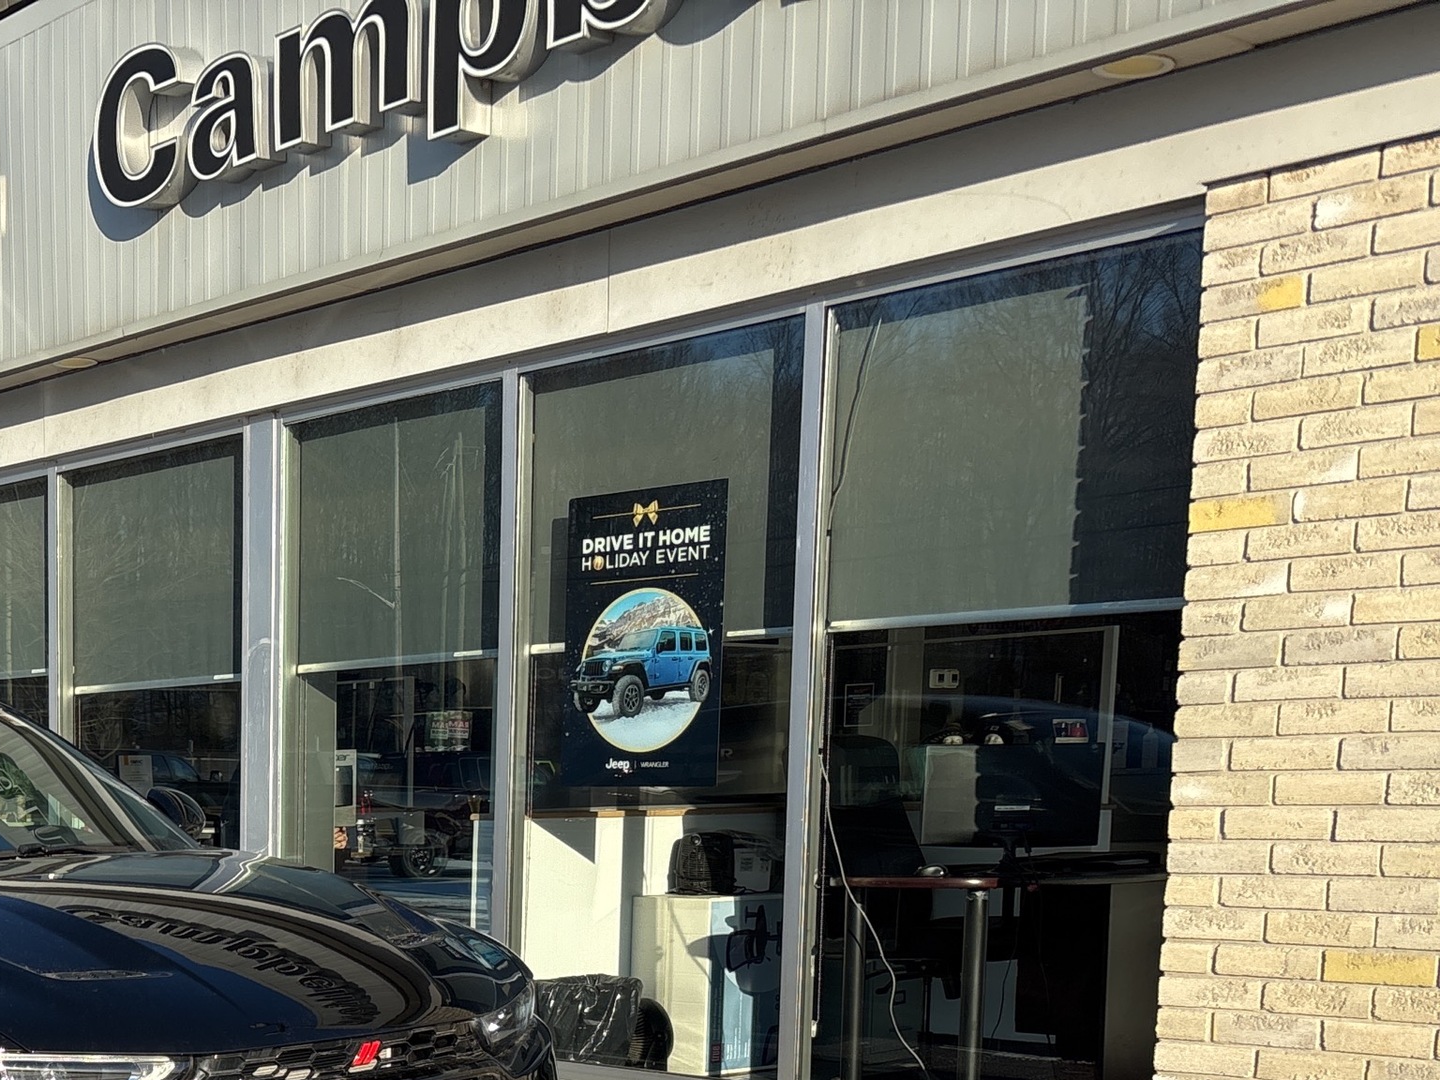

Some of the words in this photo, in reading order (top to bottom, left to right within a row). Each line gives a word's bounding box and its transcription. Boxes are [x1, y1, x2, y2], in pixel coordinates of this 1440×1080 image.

[92, 0, 654, 208] Camp
[582, 533, 634, 554] DRIVE
[638, 531, 656, 549] IT
[658, 525, 711, 546] HOME
[581, 550, 650, 572] HOLIDAY
[655, 544, 711, 564] EVENT
[605, 757, 630, 772] Jeep
[640, 761, 670, 769] WRANGLER
